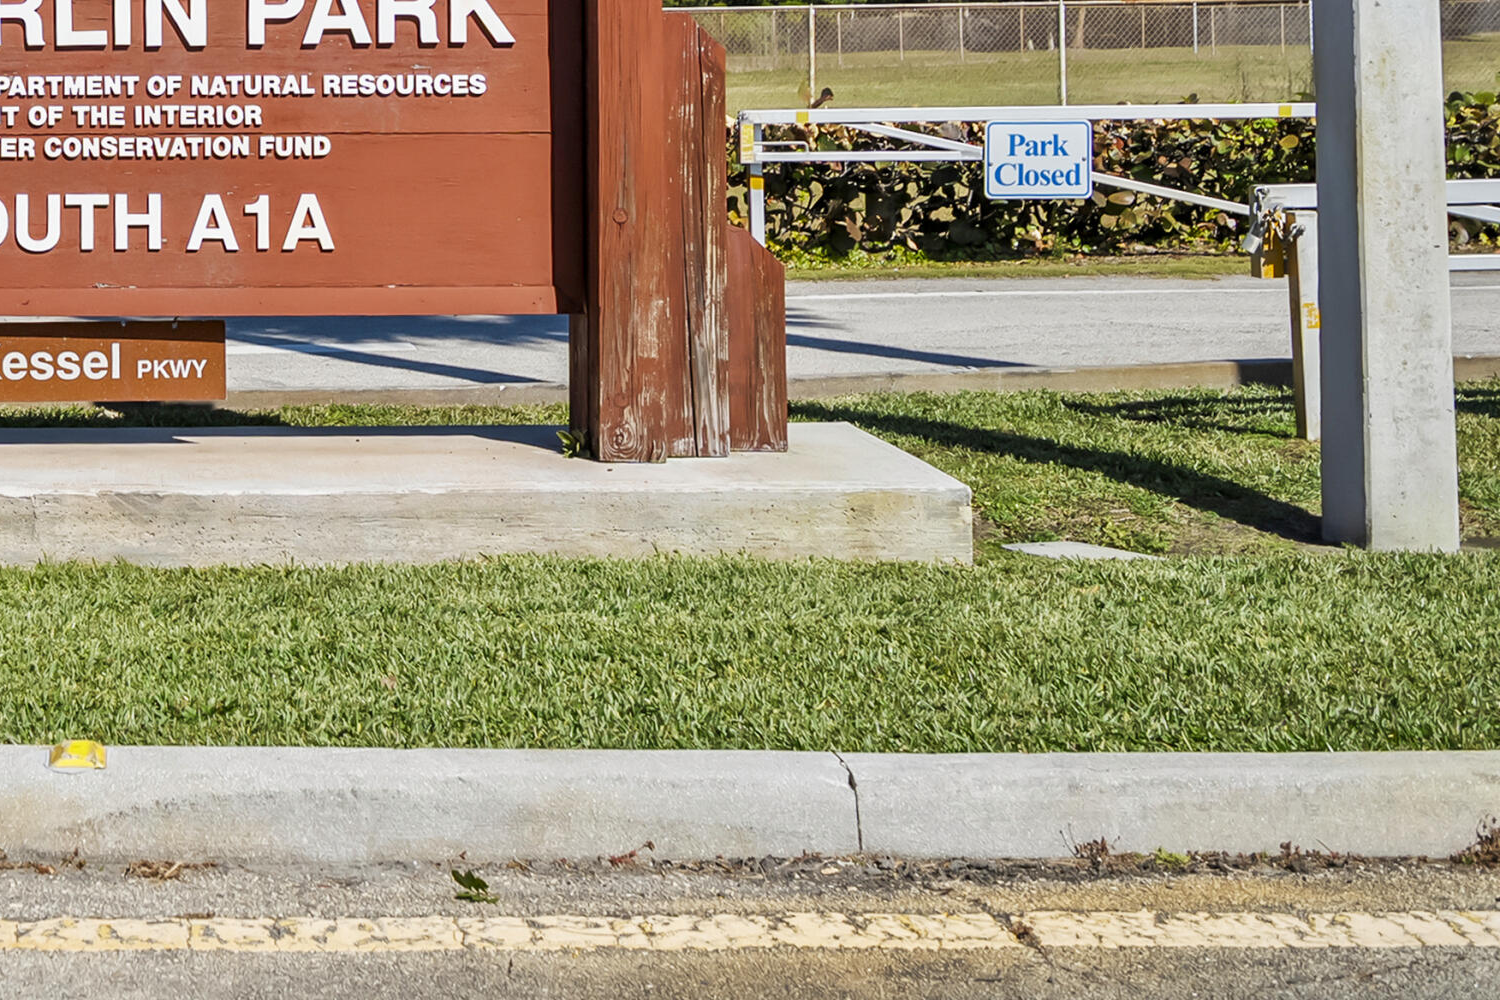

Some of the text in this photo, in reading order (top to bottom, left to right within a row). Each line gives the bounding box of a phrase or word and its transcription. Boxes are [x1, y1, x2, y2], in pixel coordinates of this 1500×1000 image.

[147, 75, 183, 96] OF
[191, 74, 316, 96] NATURAL
[323, 73, 487, 95] RESOURCES
[28, 105, 64, 126] OF
[72, 105, 126, 126] THE
[134, 104, 263, 126] INTERIOR
[44, 135, 250, 158] CONSERVATION
[259, 135, 332, 157] FUND
[1007, 133, 1069, 157] Park
[994, 163, 1082, 187] Closed
[186, 193, 335, 251] A1A
[137, 359, 208, 379] PKWY
